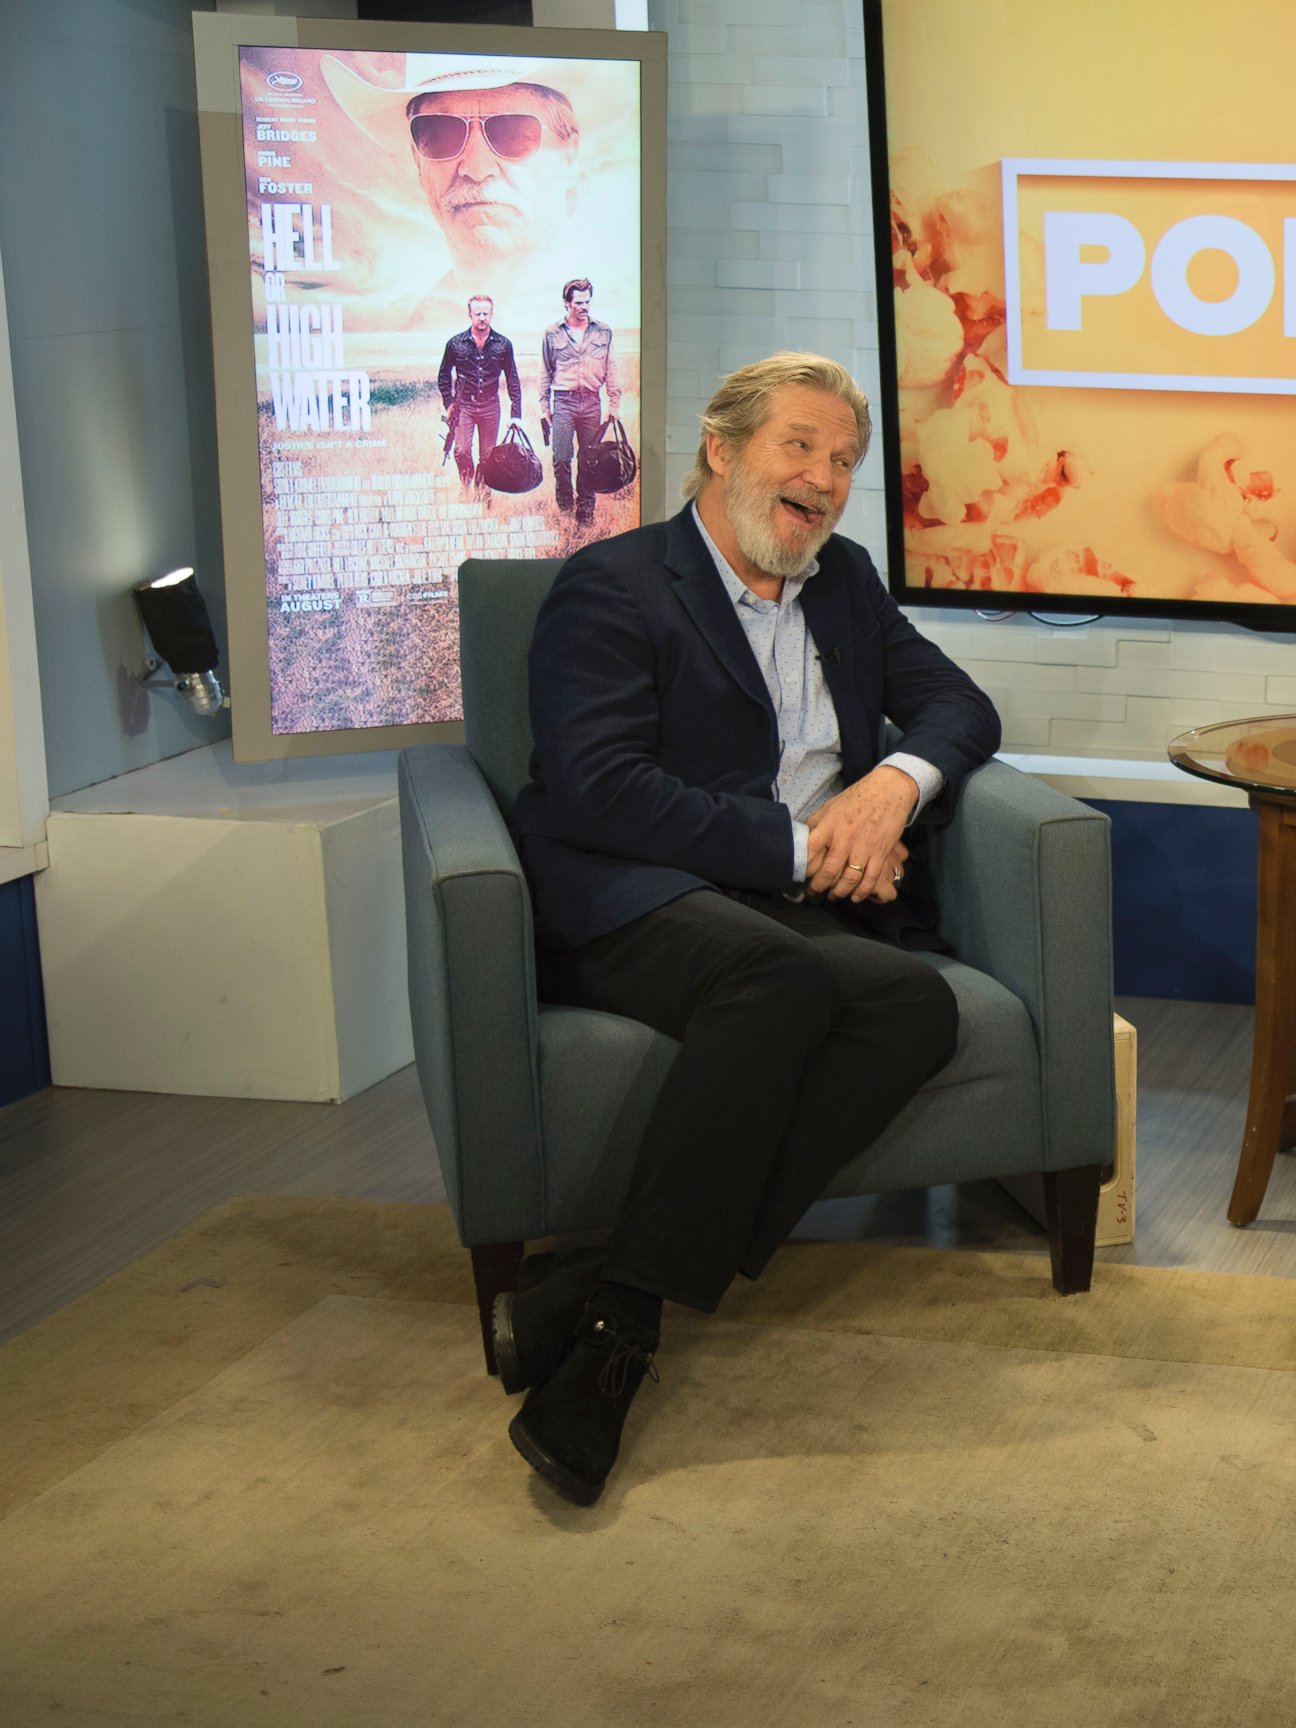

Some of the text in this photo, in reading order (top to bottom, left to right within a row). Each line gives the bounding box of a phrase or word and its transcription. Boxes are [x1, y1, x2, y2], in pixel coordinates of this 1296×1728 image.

[256, 129, 317, 142] BRIDGES
[258, 156, 291, 168] PINE
[259, 182, 313, 194] FOSTER
[260, 203, 341, 272] HELL
[264, 271, 286, 303] OR
[266, 303, 344, 370] HIGH
[270, 369, 372, 432] WATER
[280, 599, 341, 612] AUGUST
[1116, 1191, 1128, 1224] TV-3
